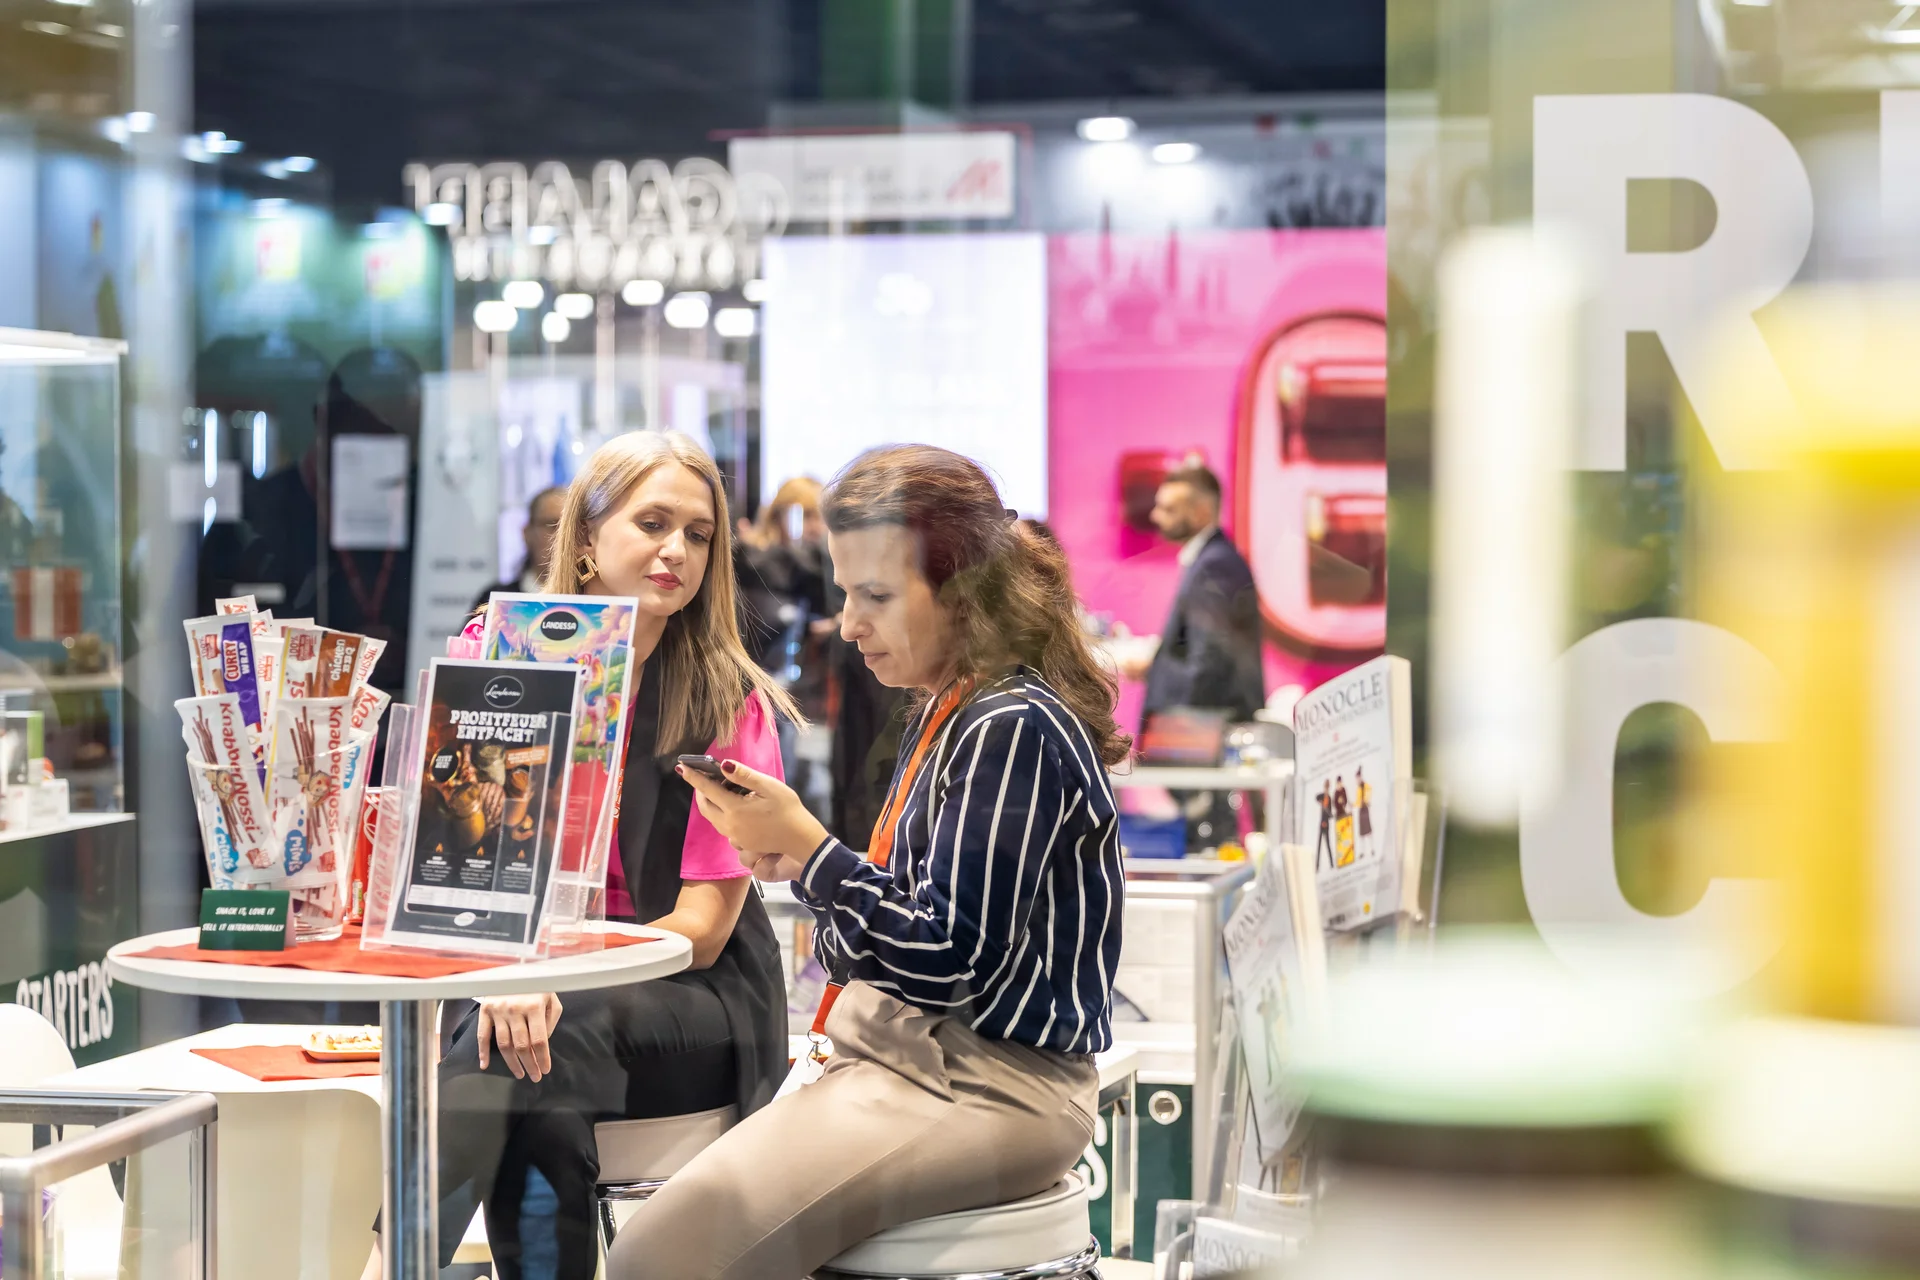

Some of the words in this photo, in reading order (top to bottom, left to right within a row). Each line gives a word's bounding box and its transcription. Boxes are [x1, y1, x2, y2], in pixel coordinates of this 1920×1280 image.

[542, 621, 577, 631] LANDESSA
[289, 635, 299, 658] 100%
[224, 641, 240, 680] CURRY
[240, 642, 250, 675] WRAP
[343, 646, 355, 674] BBQ
[1296, 672, 1382, 731] MONOCLE
[450, 710, 548, 729] PROFITFEUER
[456, 725, 534, 743] ENTFACHT
[215, 907, 238, 915] SNACK
[248, 907, 266, 915] LOVE
[266, 907, 276, 915] IT
[202, 923, 217, 931] SELL
[218, 923, 227, 931] IT
[227, 923, 285, 932] INTERNATIONALLY
